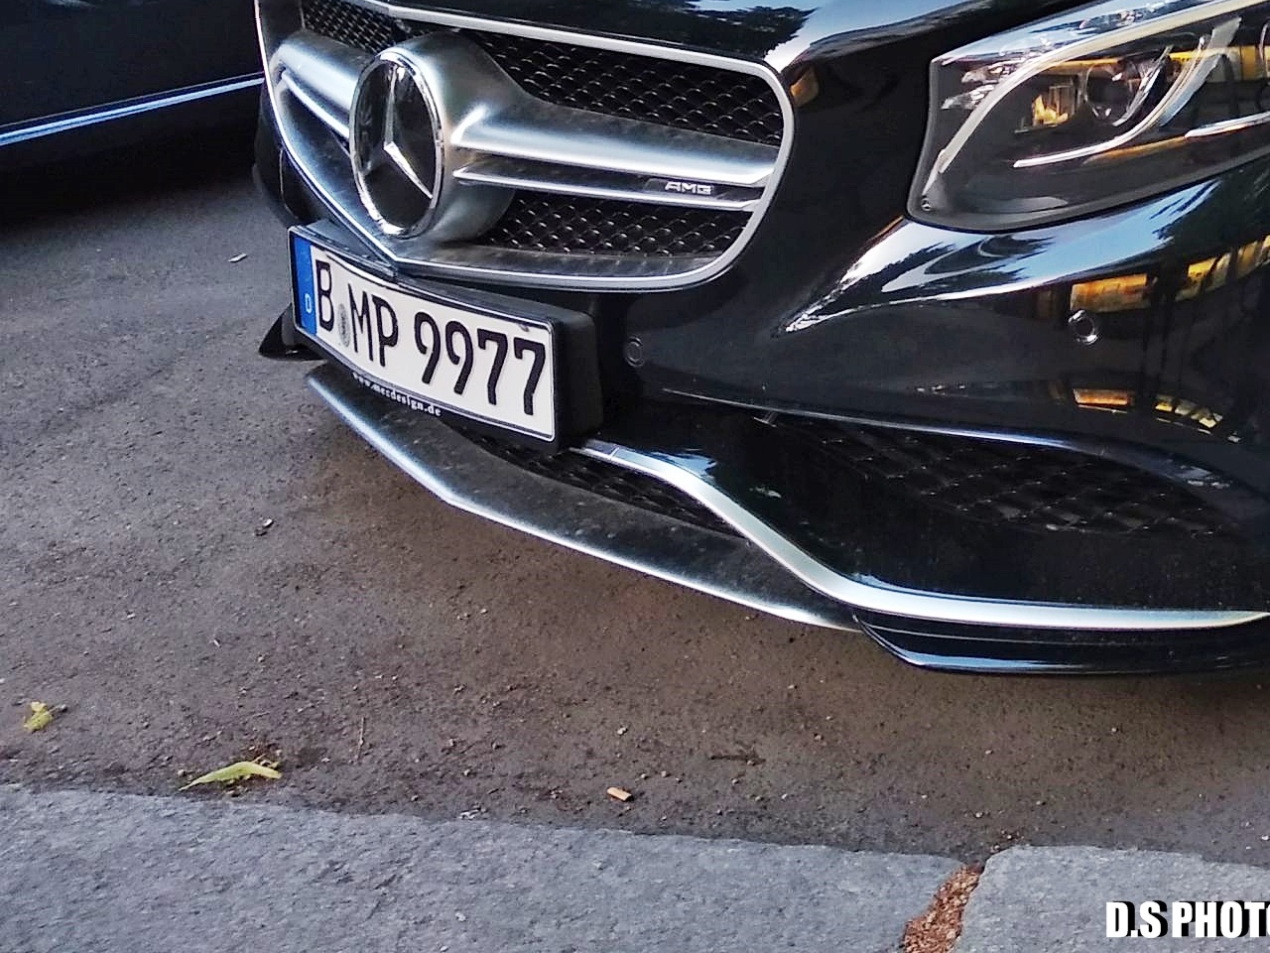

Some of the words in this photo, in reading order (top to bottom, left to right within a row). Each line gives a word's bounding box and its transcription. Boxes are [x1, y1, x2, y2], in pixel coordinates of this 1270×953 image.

[664, 181, 712, 195] AMG
[315, 259, 335, 332] B
[347, 282, 399, 368] MP
[413, 310, 546, 417] 9977
